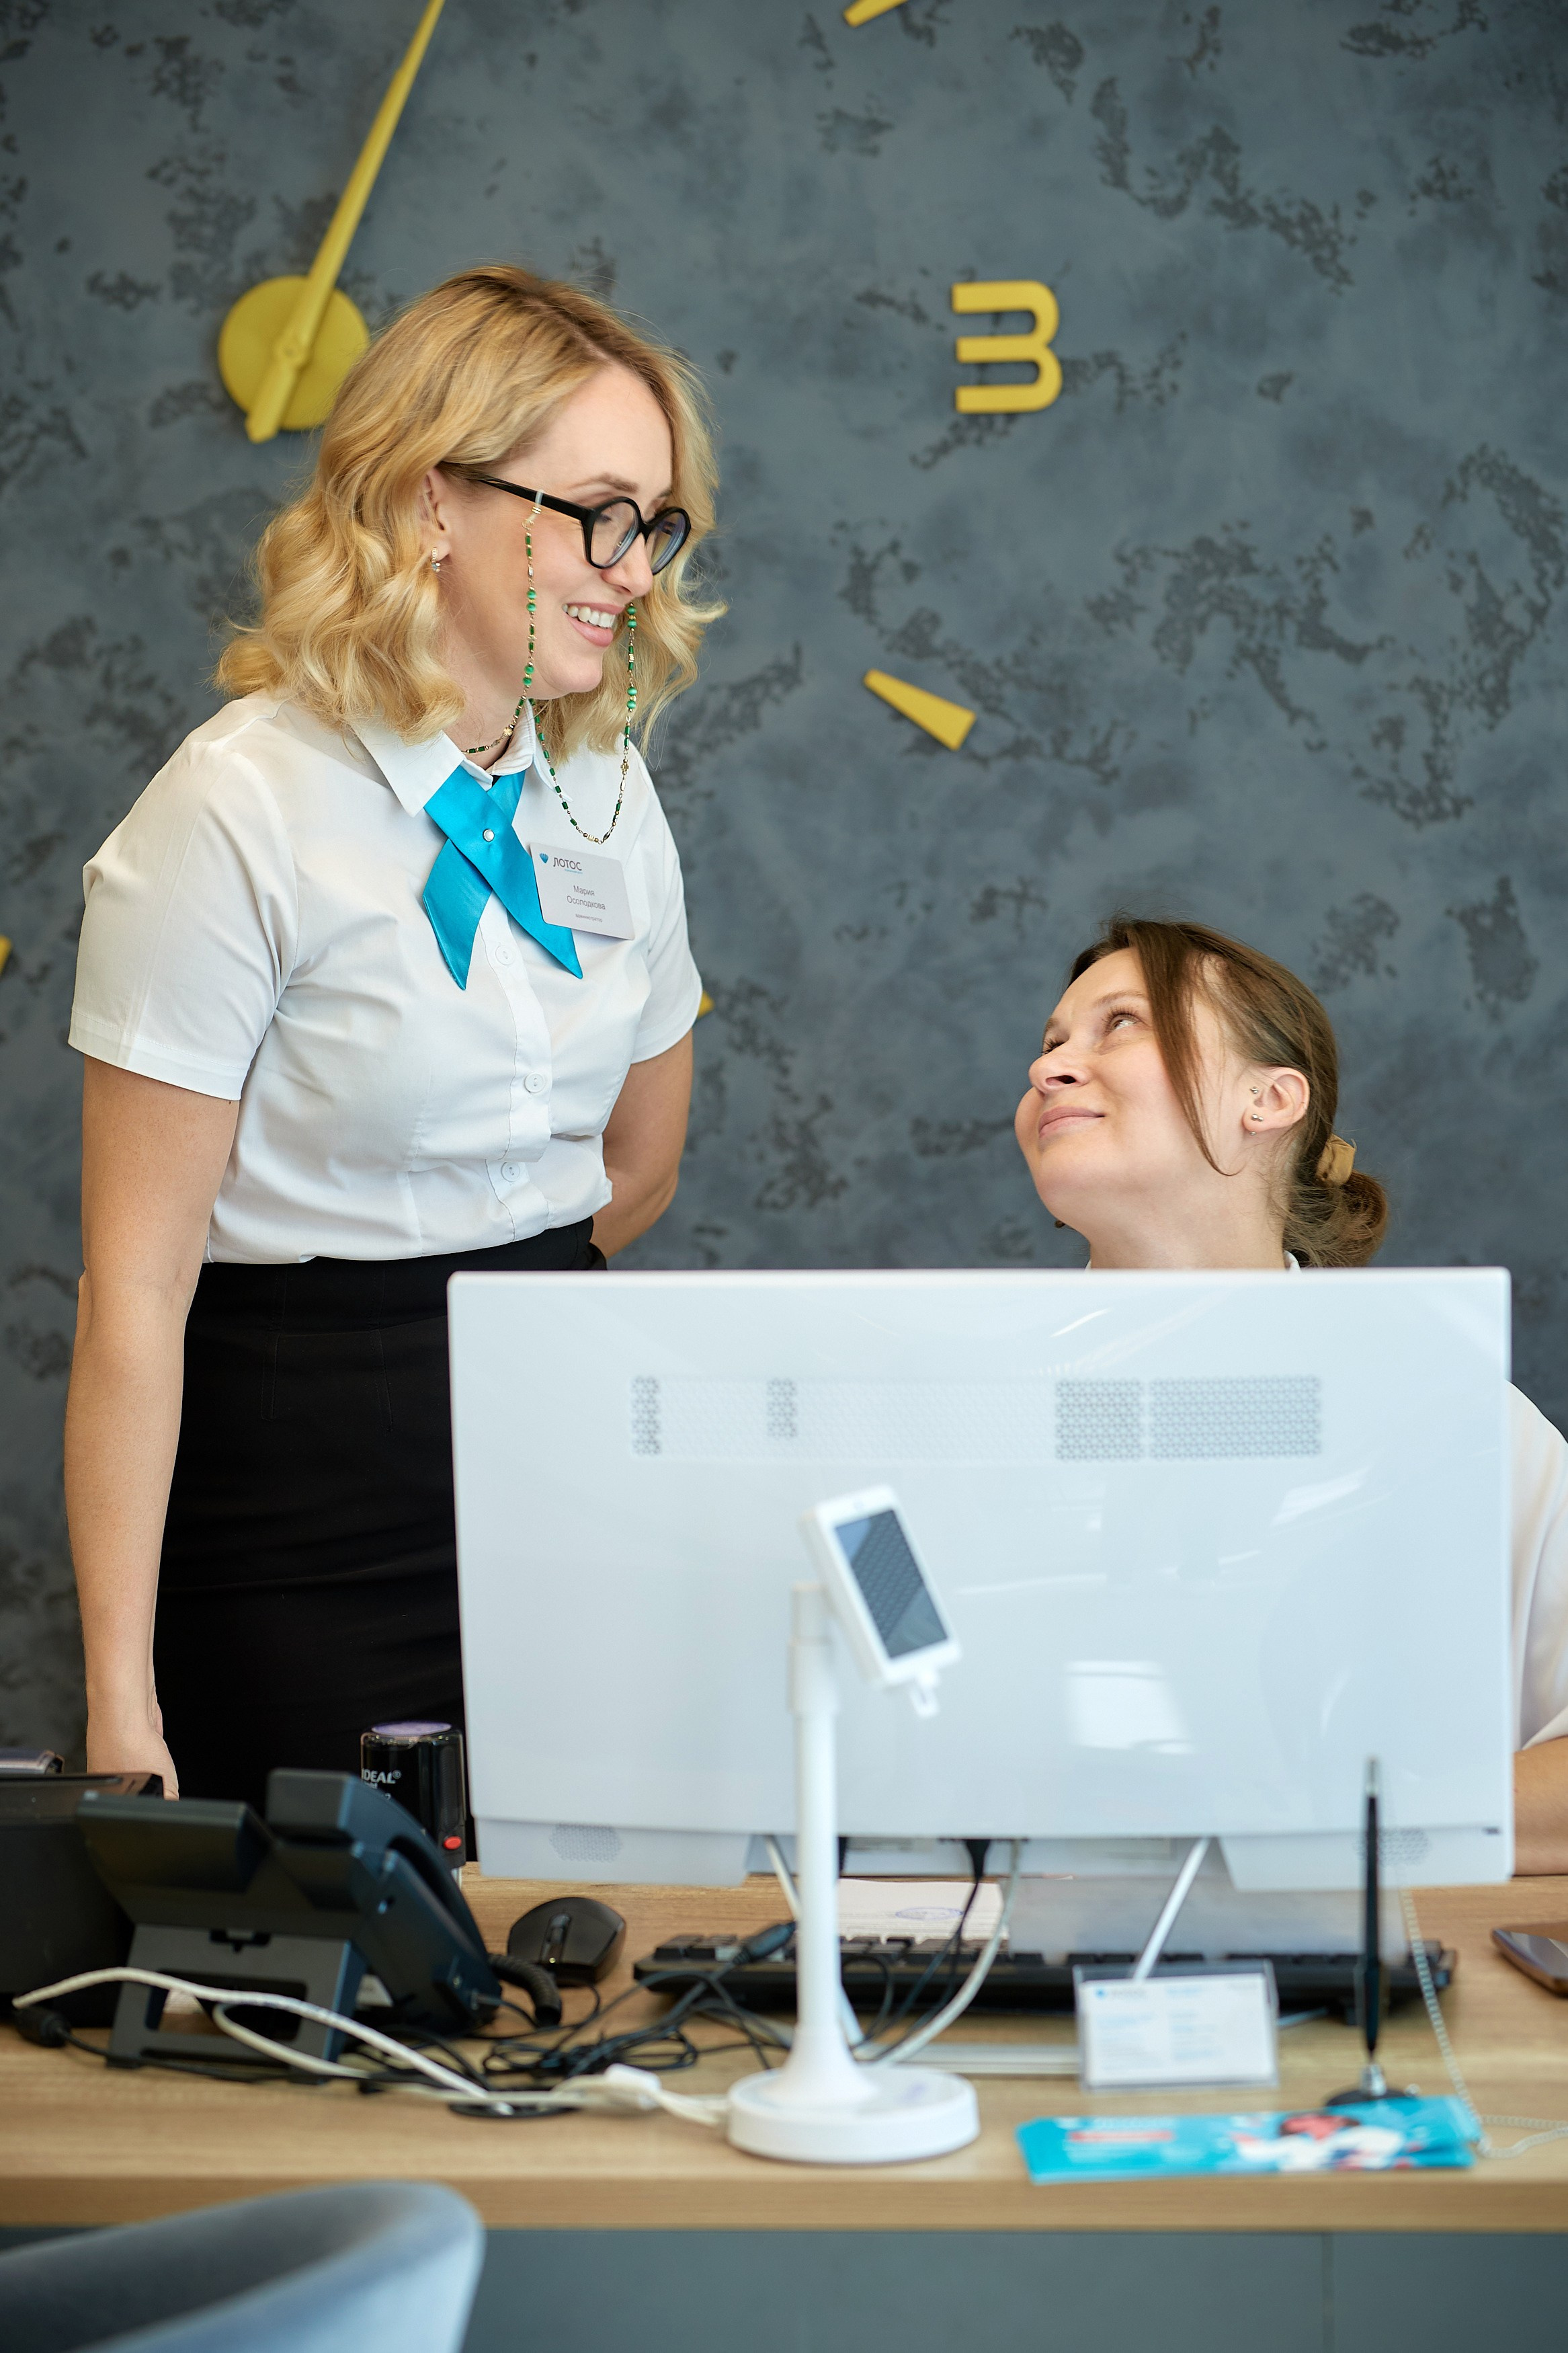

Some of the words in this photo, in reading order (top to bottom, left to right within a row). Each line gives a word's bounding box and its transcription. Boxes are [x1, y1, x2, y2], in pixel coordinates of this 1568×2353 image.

[951, 280, 1063, 414] 3
[553, 857, 582, 871] ЛОТОС
[573, 885, 595, 896] Мария
